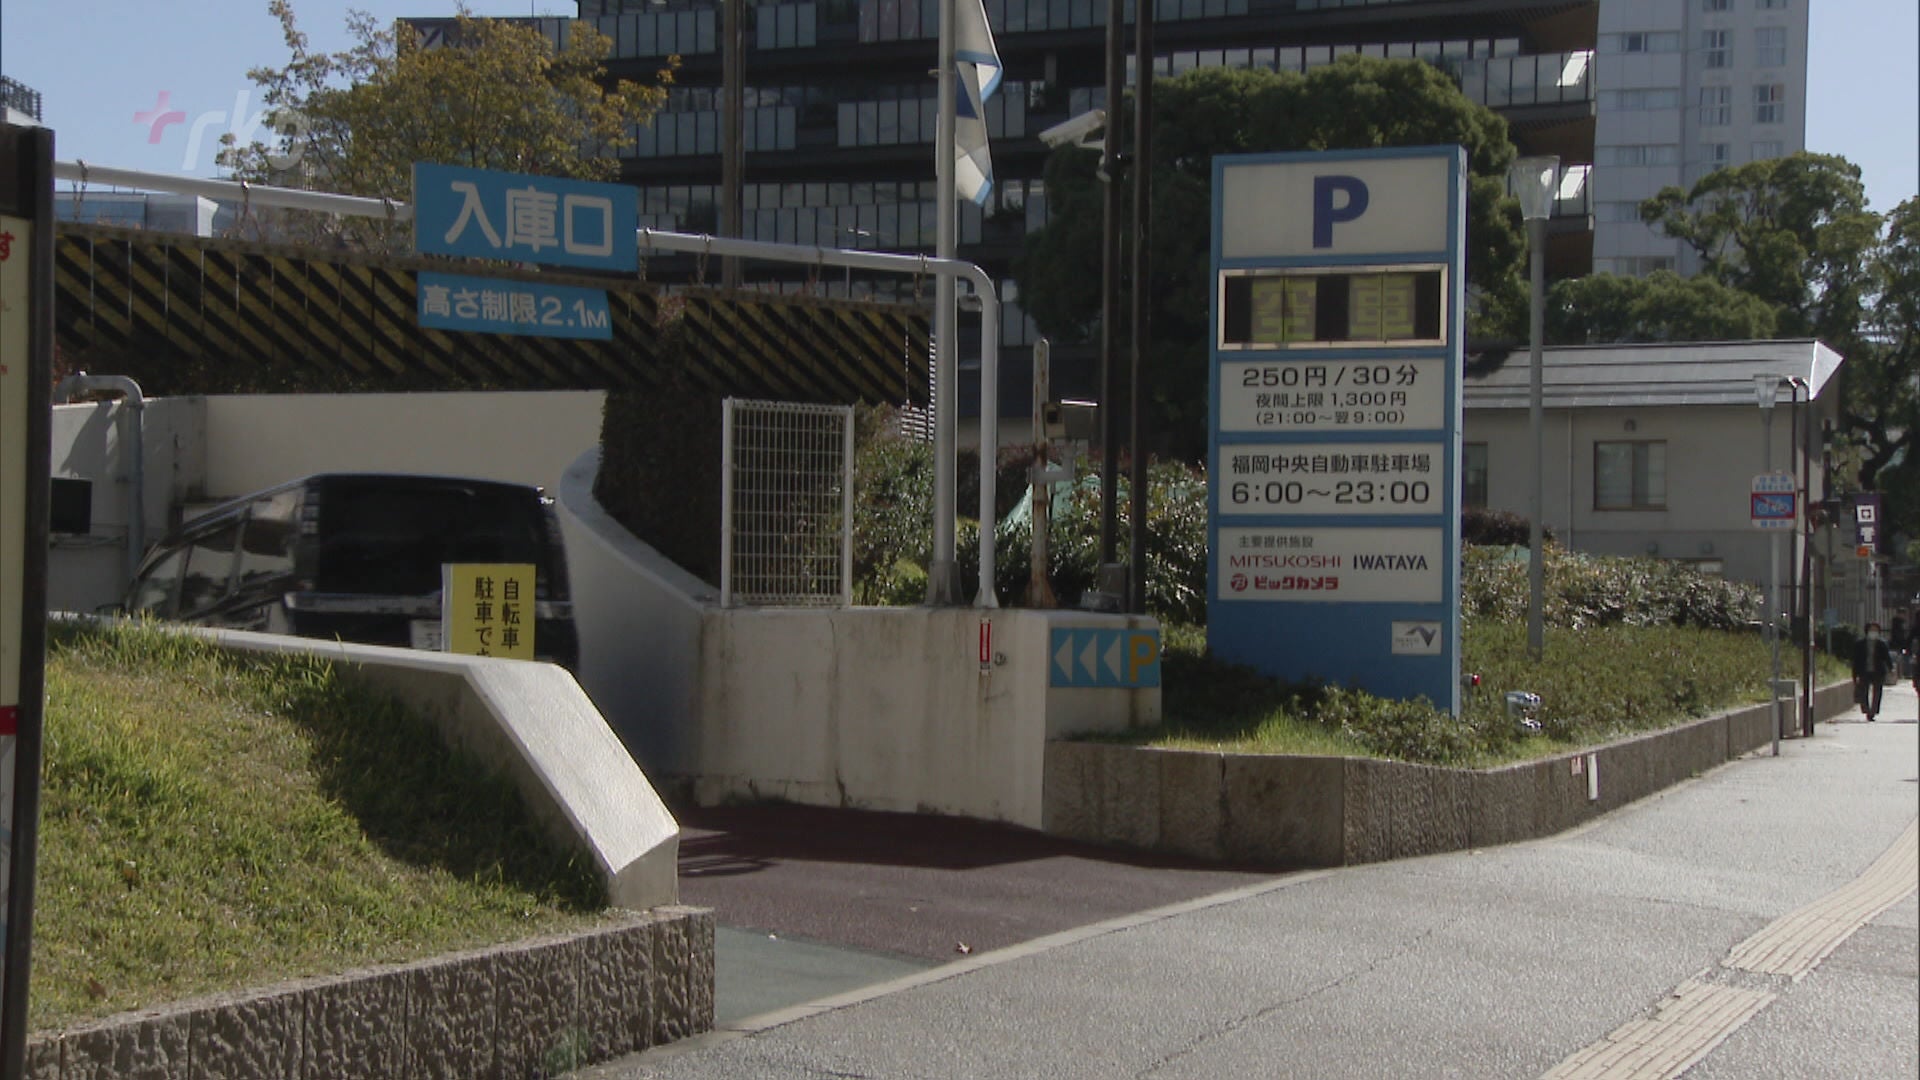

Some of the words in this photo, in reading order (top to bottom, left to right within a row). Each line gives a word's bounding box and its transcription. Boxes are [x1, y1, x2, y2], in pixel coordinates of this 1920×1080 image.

[443, 181, 613, 257] 入庫口
[1312, 175, 1369, 249] P
[422, 284, 609, 328] 高さ制限2.1M
[1232, 454, 1431, 475] 福岡中央自動車駐車場
[1230, 555, 1341, 568] MITSUKOSHI
[1353, 555, 1428, 570] IWATAYA
[501, 577, 521, 650] 自転車
[1129, 635, 1157, 682] P
